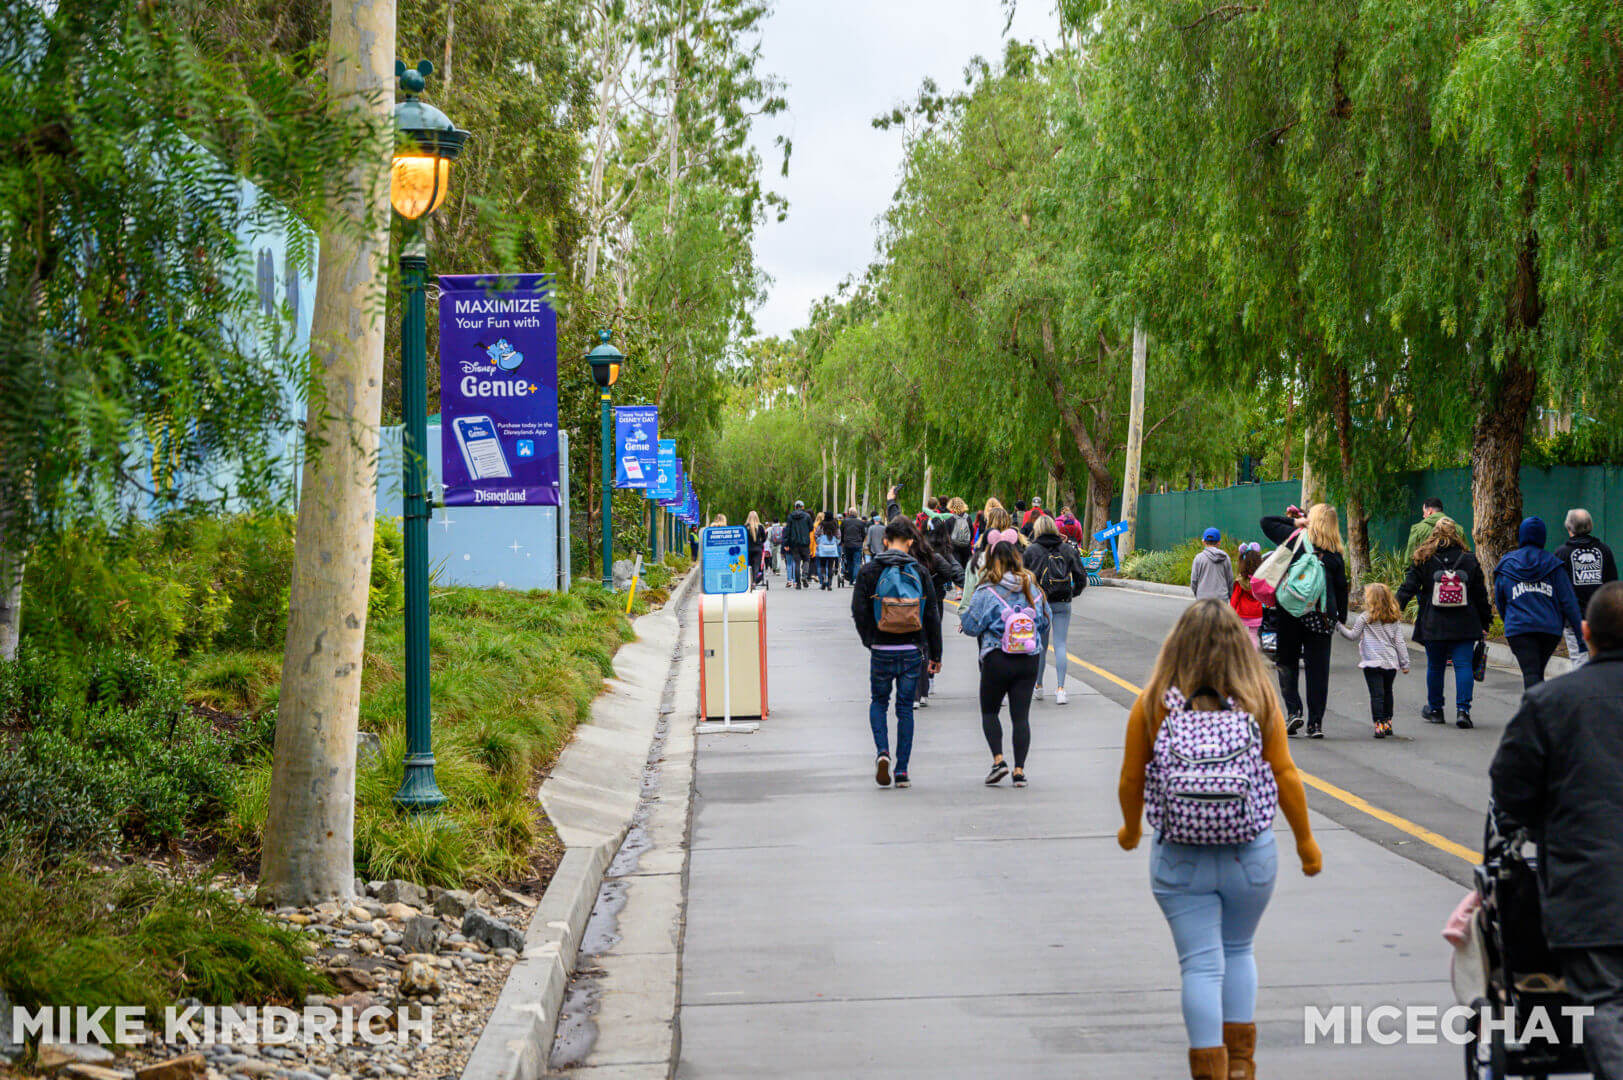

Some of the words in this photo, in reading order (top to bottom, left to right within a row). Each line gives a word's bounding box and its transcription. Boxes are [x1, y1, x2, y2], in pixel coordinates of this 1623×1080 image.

[455, 299, 540, 313] MAXIMIZE
[455, 317, 484, 329] Your
[487, 316, 510, 328] Fun
[513, 315, 540, 328] with
[459, 360, 497, 376] Disney
[535, 428, 547, 436] App
[625, 442, 650, 451] Genie
[474, 488, 526, 504] Disneyland
[1576, 569, 1602, 581] VANS
